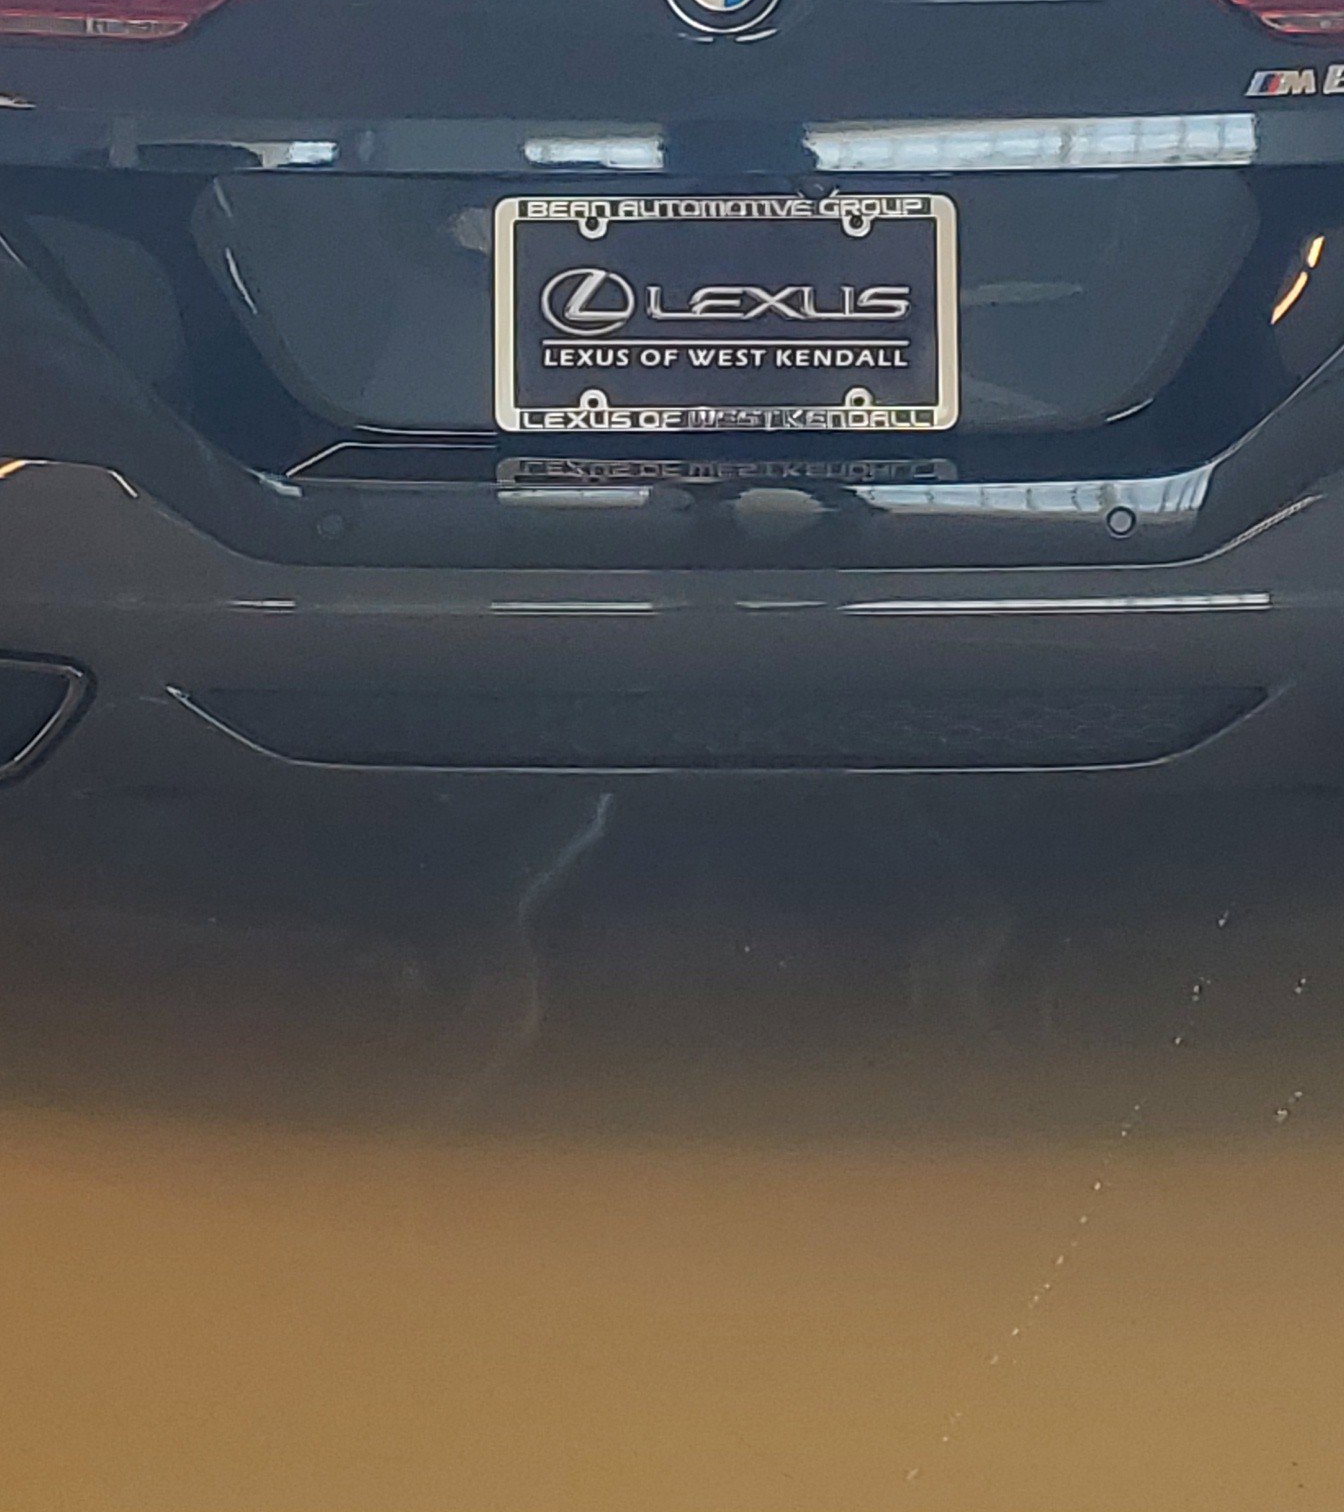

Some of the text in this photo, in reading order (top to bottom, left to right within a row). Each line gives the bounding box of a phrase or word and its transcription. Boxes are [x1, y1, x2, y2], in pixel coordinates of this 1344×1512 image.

[527, 198, 923, 218] BEAN AUTOMOTIVE GROUP
[646, 286, 911, 321] LEXUS
[543, 348, 909, 367] LEXUS OF WEST KENDALL
[522, 410, 632, 429] LEXUS
[638, 410, 683, 429] OF
[781, 409, 932, 429] KENDALL
